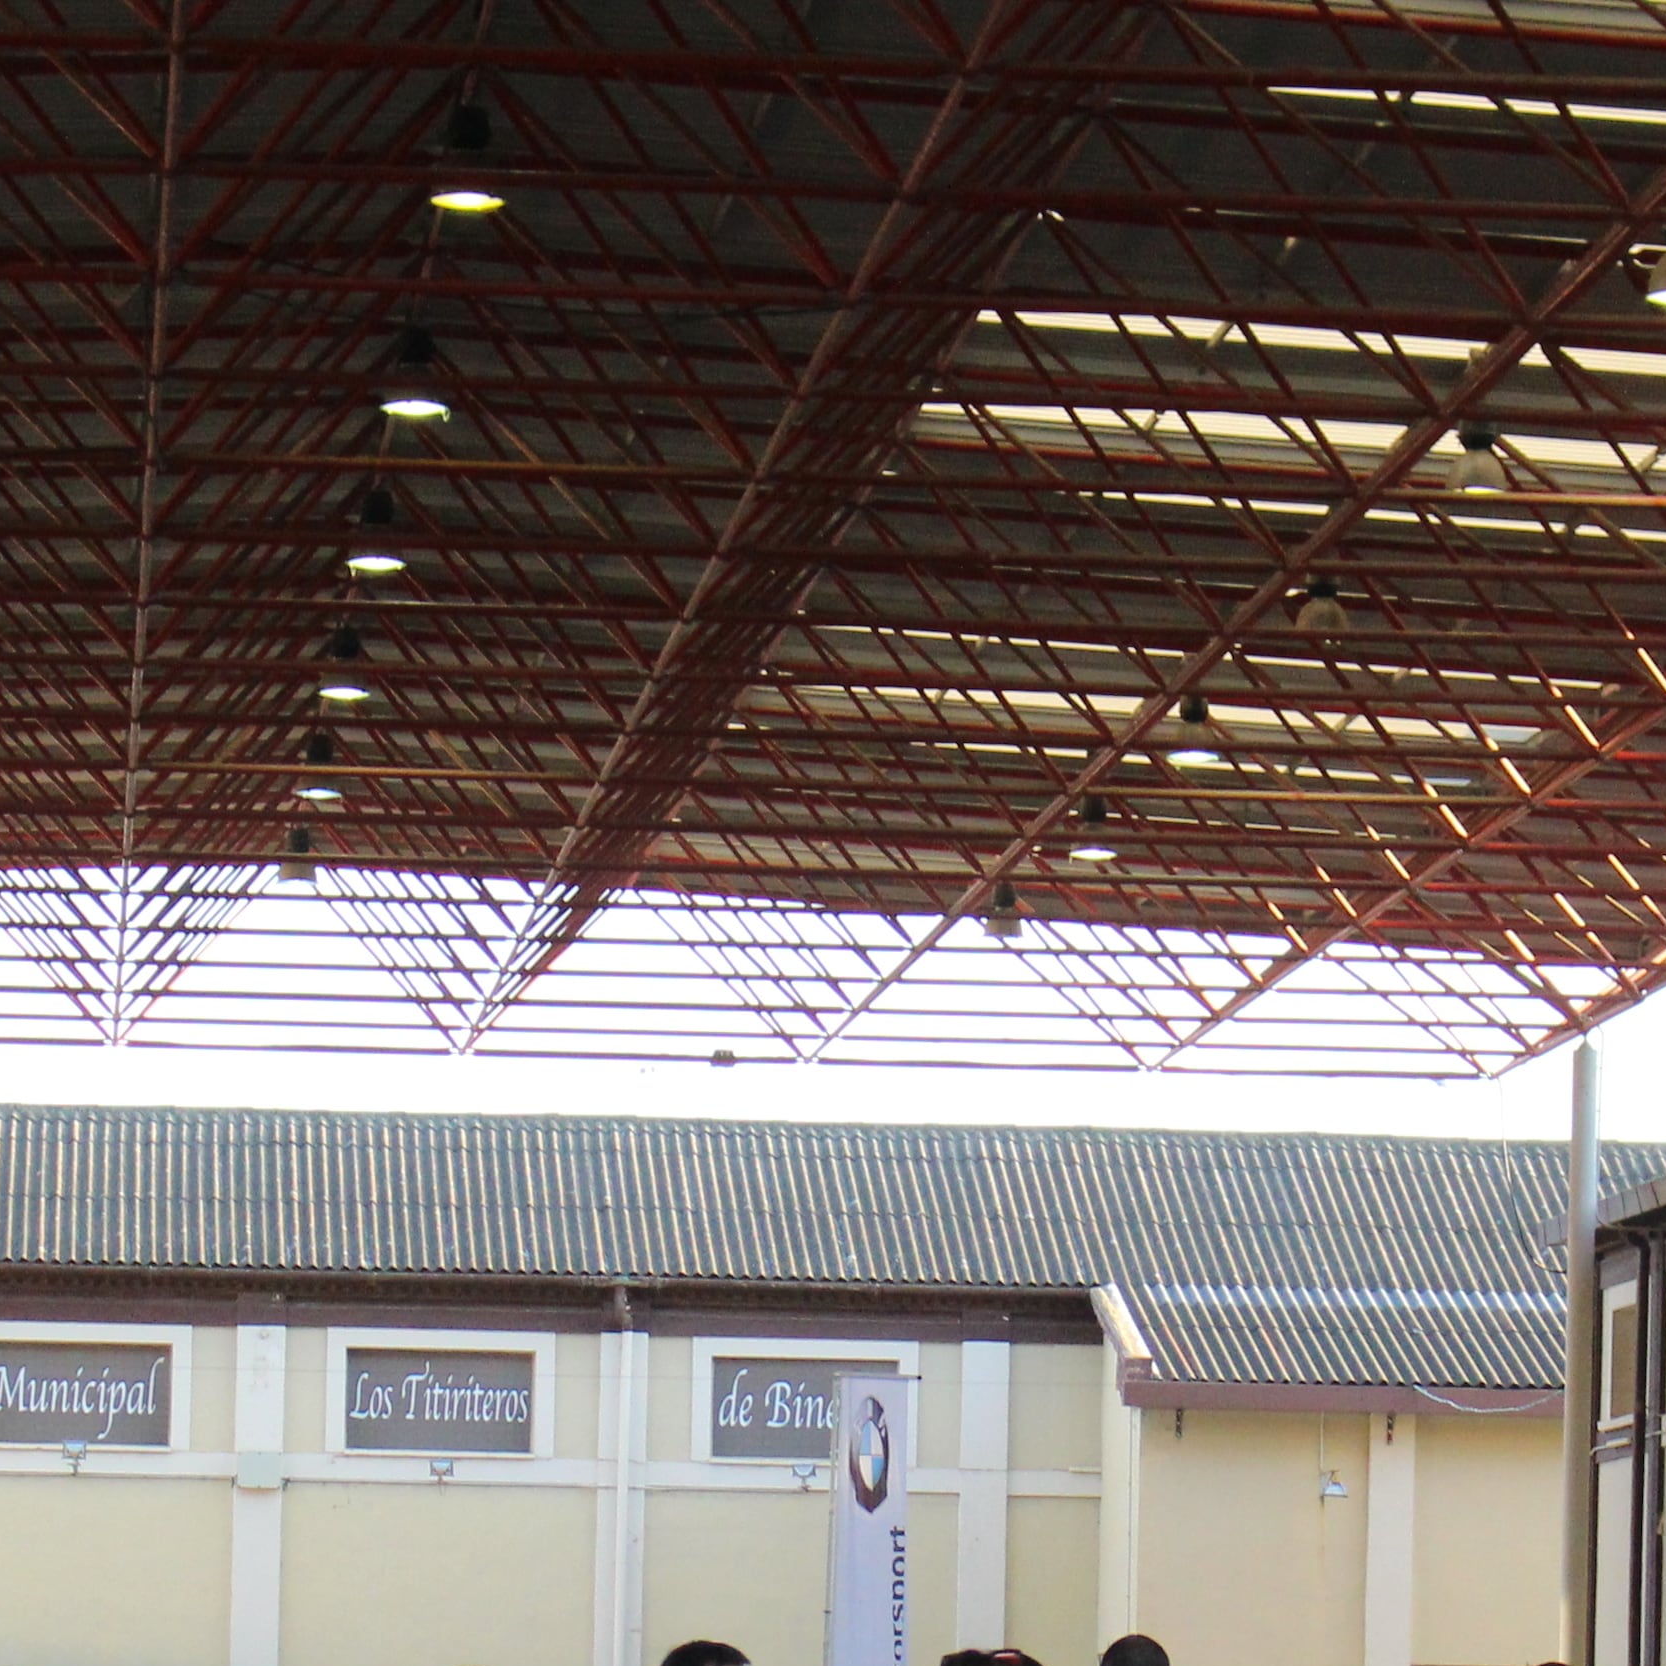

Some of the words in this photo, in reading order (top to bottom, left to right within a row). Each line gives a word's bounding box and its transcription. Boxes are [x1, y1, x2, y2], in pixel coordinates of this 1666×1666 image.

[349, 1372, 394, 1420] Los
[401, 1360, 529, 1424] Titiriteros
[719, 1368, 754, 1428] de
